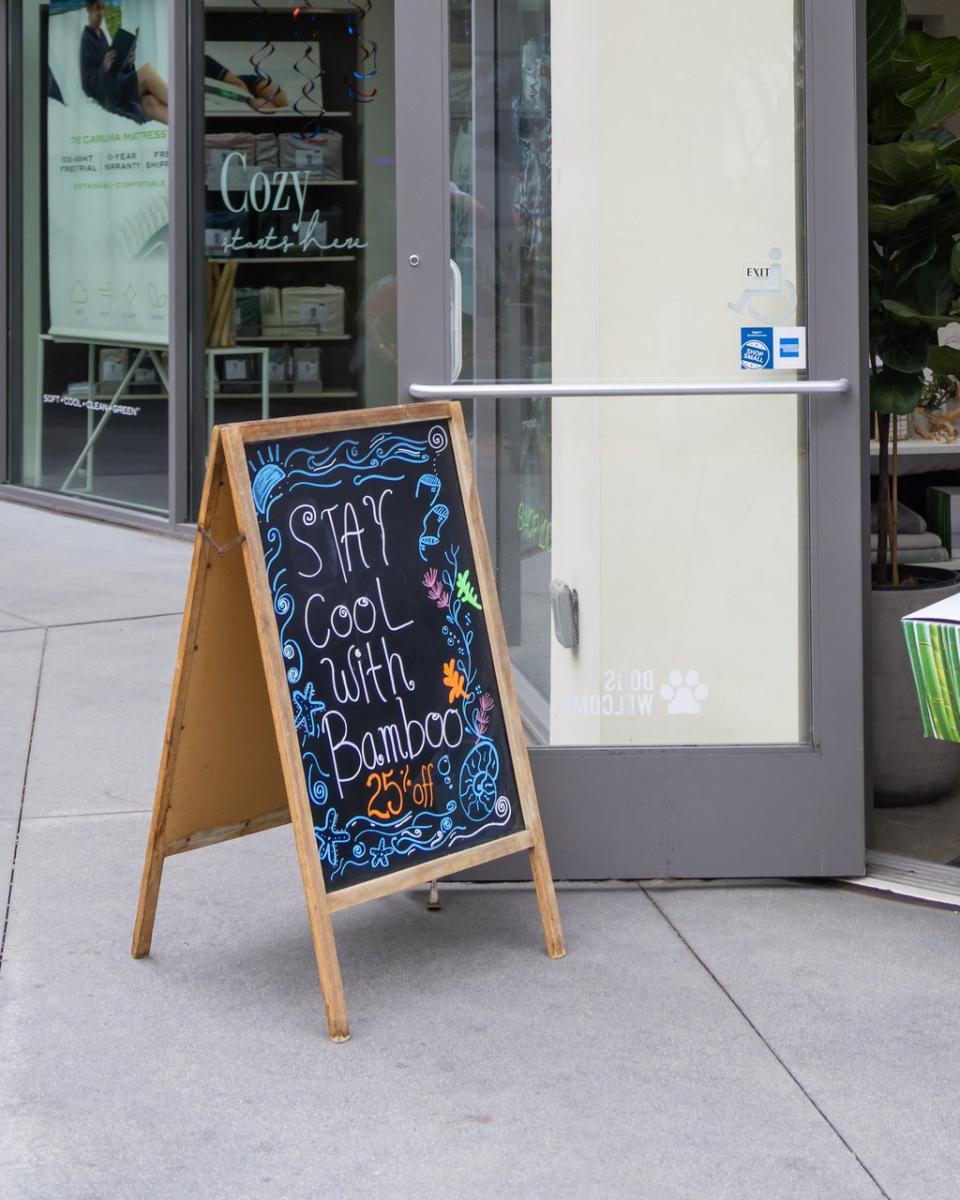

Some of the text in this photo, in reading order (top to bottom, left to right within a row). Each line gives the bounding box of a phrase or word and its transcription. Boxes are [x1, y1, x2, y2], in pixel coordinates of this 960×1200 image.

[220, 152, 312, 232] Cozy
[222, 209, 369, 253] starts here
[747, 268, 770, 277] EXIT
[289, 489, 393, 583] STAY
[321, 698, 463, 799] Bamboo
[412, 763, 434, 808] off
